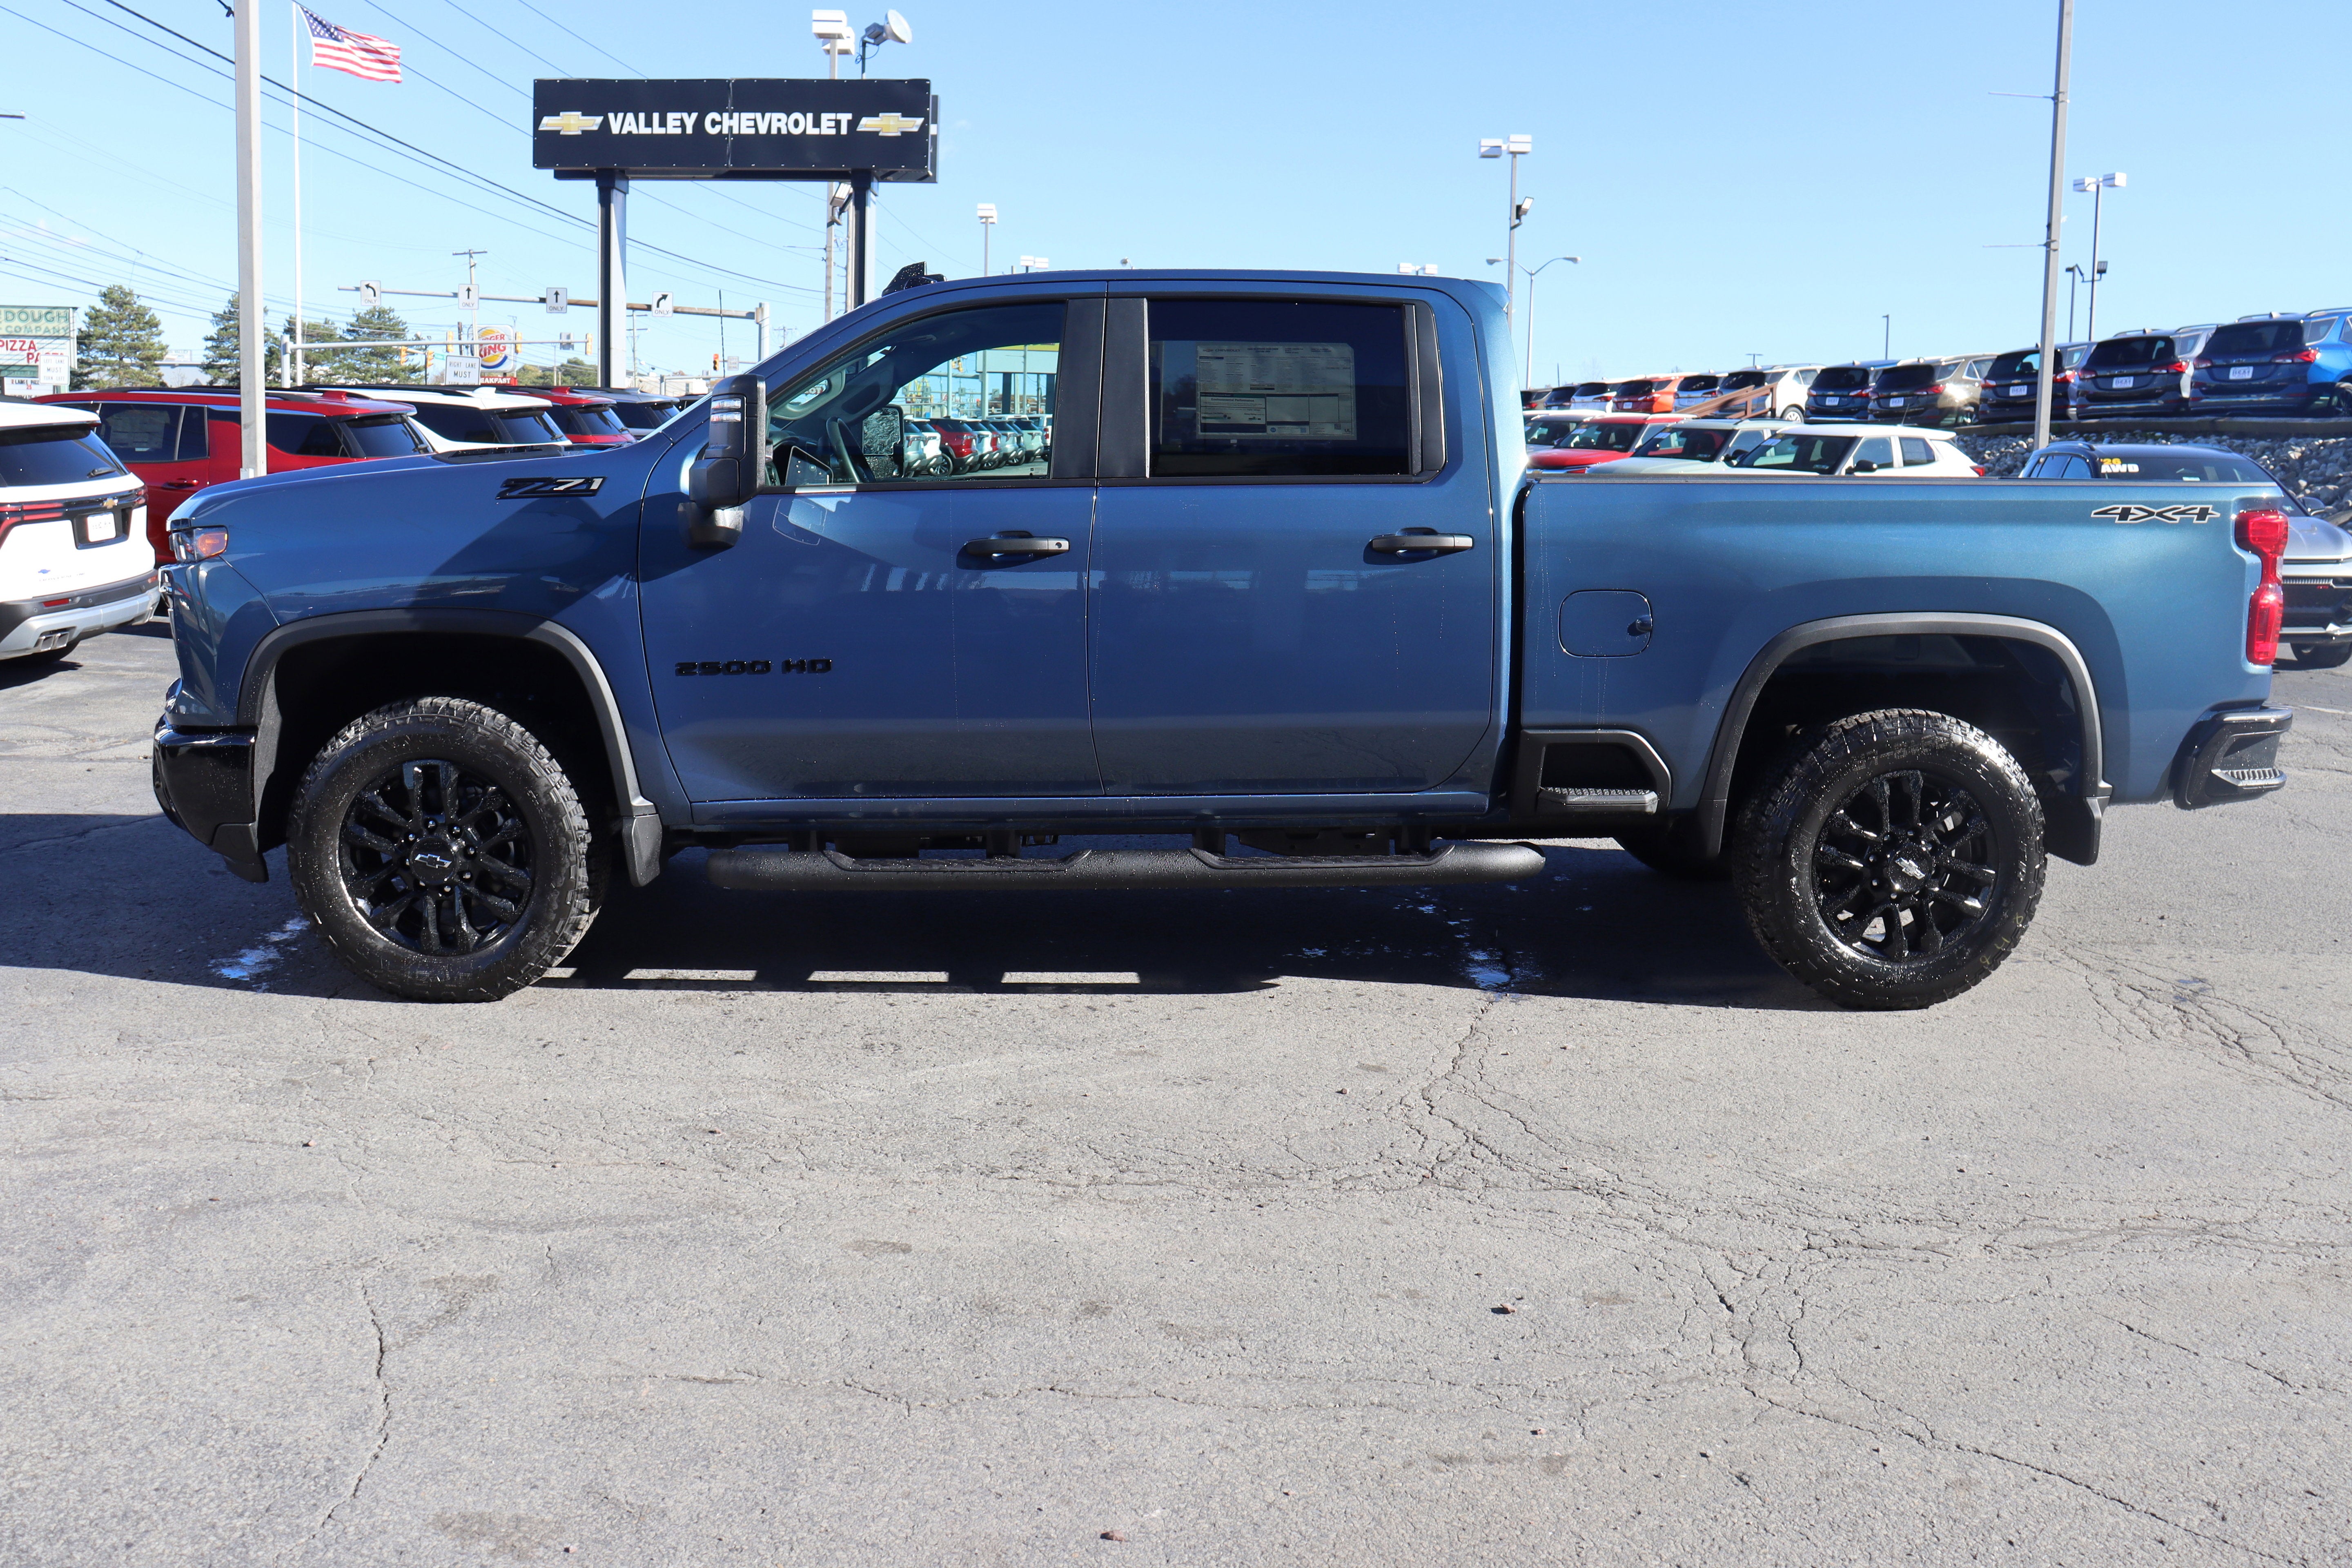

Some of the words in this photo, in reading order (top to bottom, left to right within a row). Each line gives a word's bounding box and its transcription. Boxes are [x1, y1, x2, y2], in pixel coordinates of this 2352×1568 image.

[608, 112, 698, 134] VALLEY
[704, 112, 852, 134] CHEVROLET
[4, 310, 69, 323] DOUGH
[5, 326, 69, 334] COMPANY
[2101, 463, 2139, 473] AWD
[495, 476, 607, 500] Z71
[675, 660, 772, 676] 2500
[782, 659, 832, 674] HD
